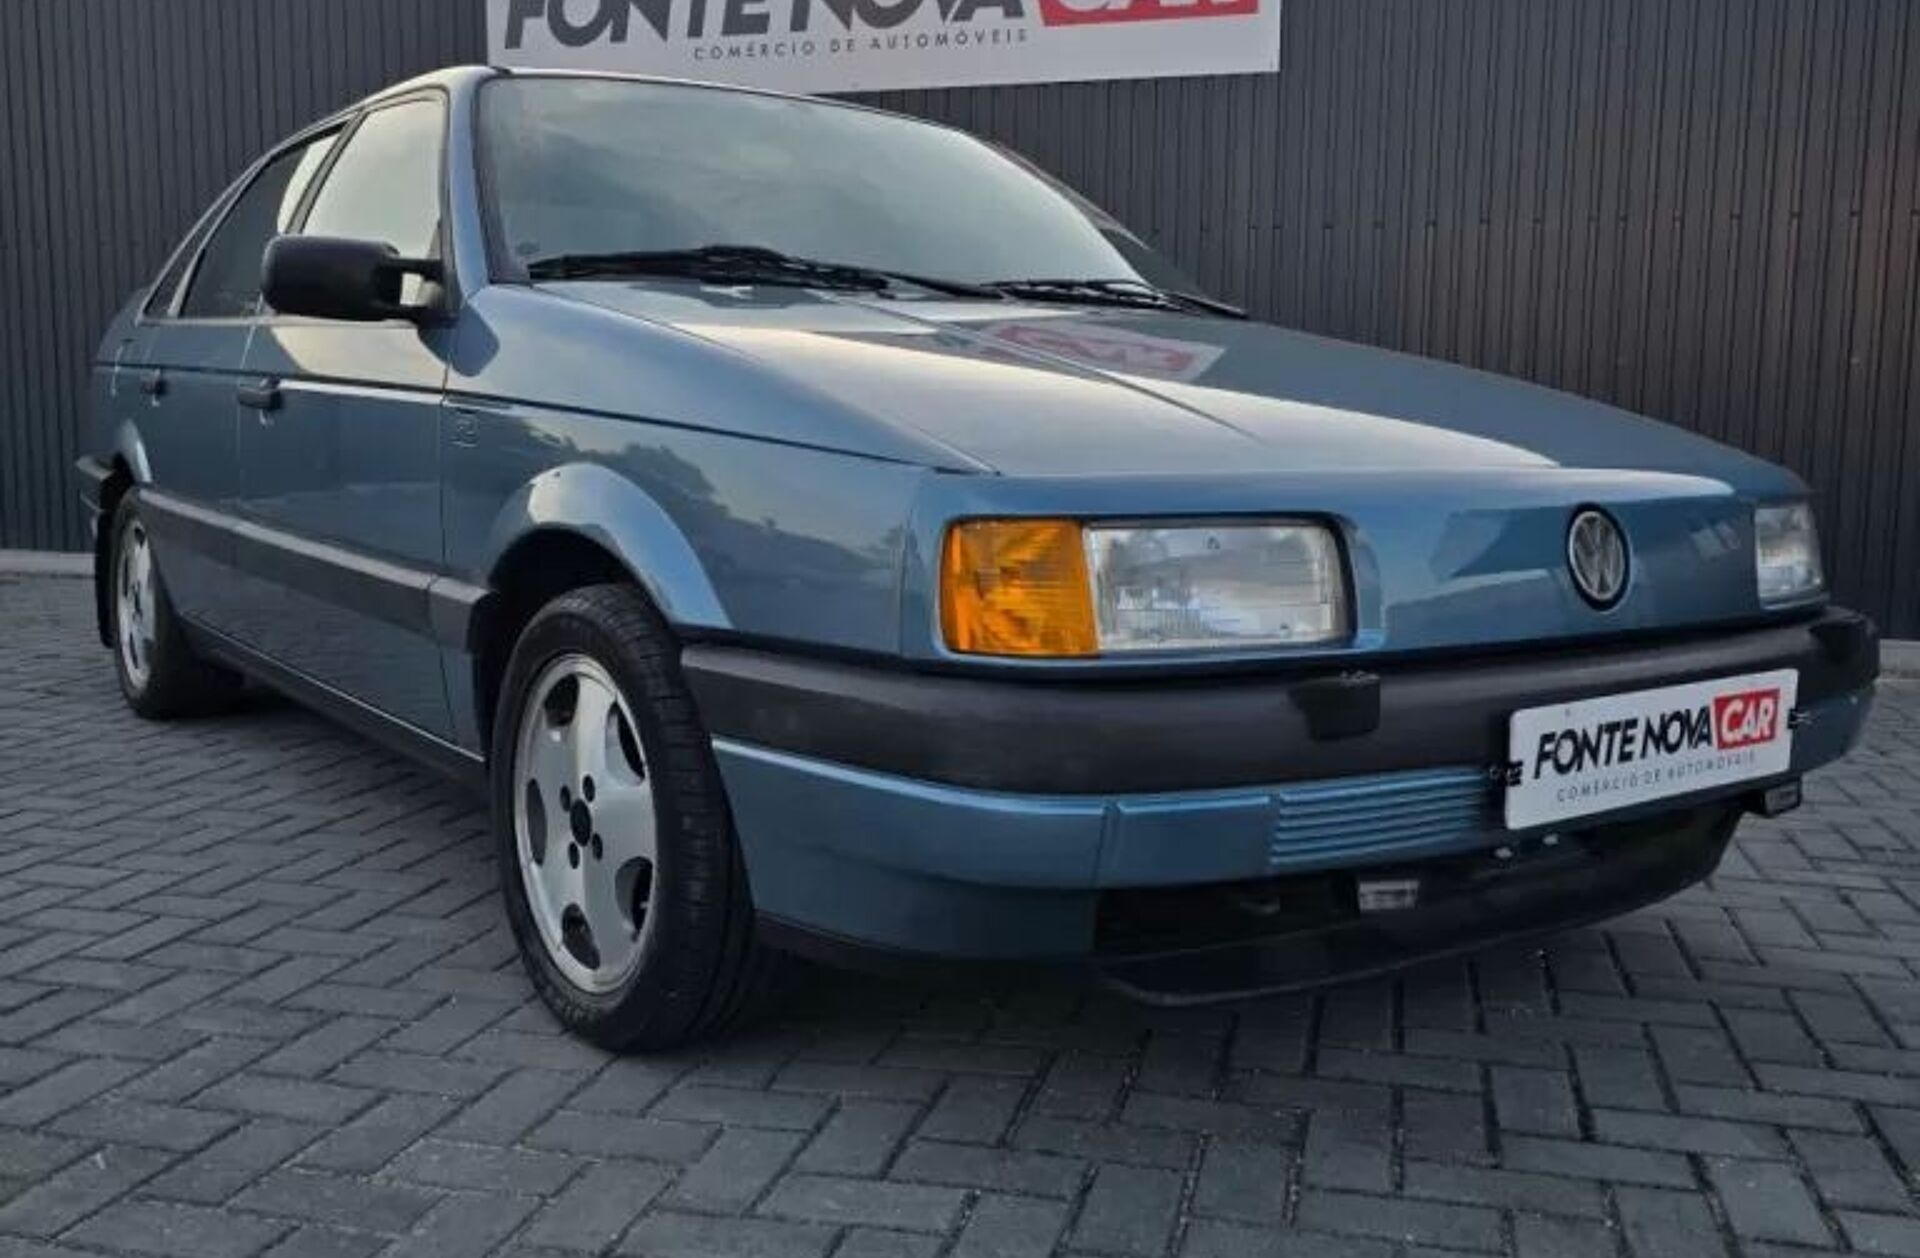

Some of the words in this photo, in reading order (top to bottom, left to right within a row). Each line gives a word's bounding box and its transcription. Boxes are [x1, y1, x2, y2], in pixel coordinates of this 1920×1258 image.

[829, 38, 857, 53] DE
[1533, 717, 1639, 780] FONTE
[1640, 705, 1711, 759] NOVA
[1720, 697, 1775, 743] CAR
